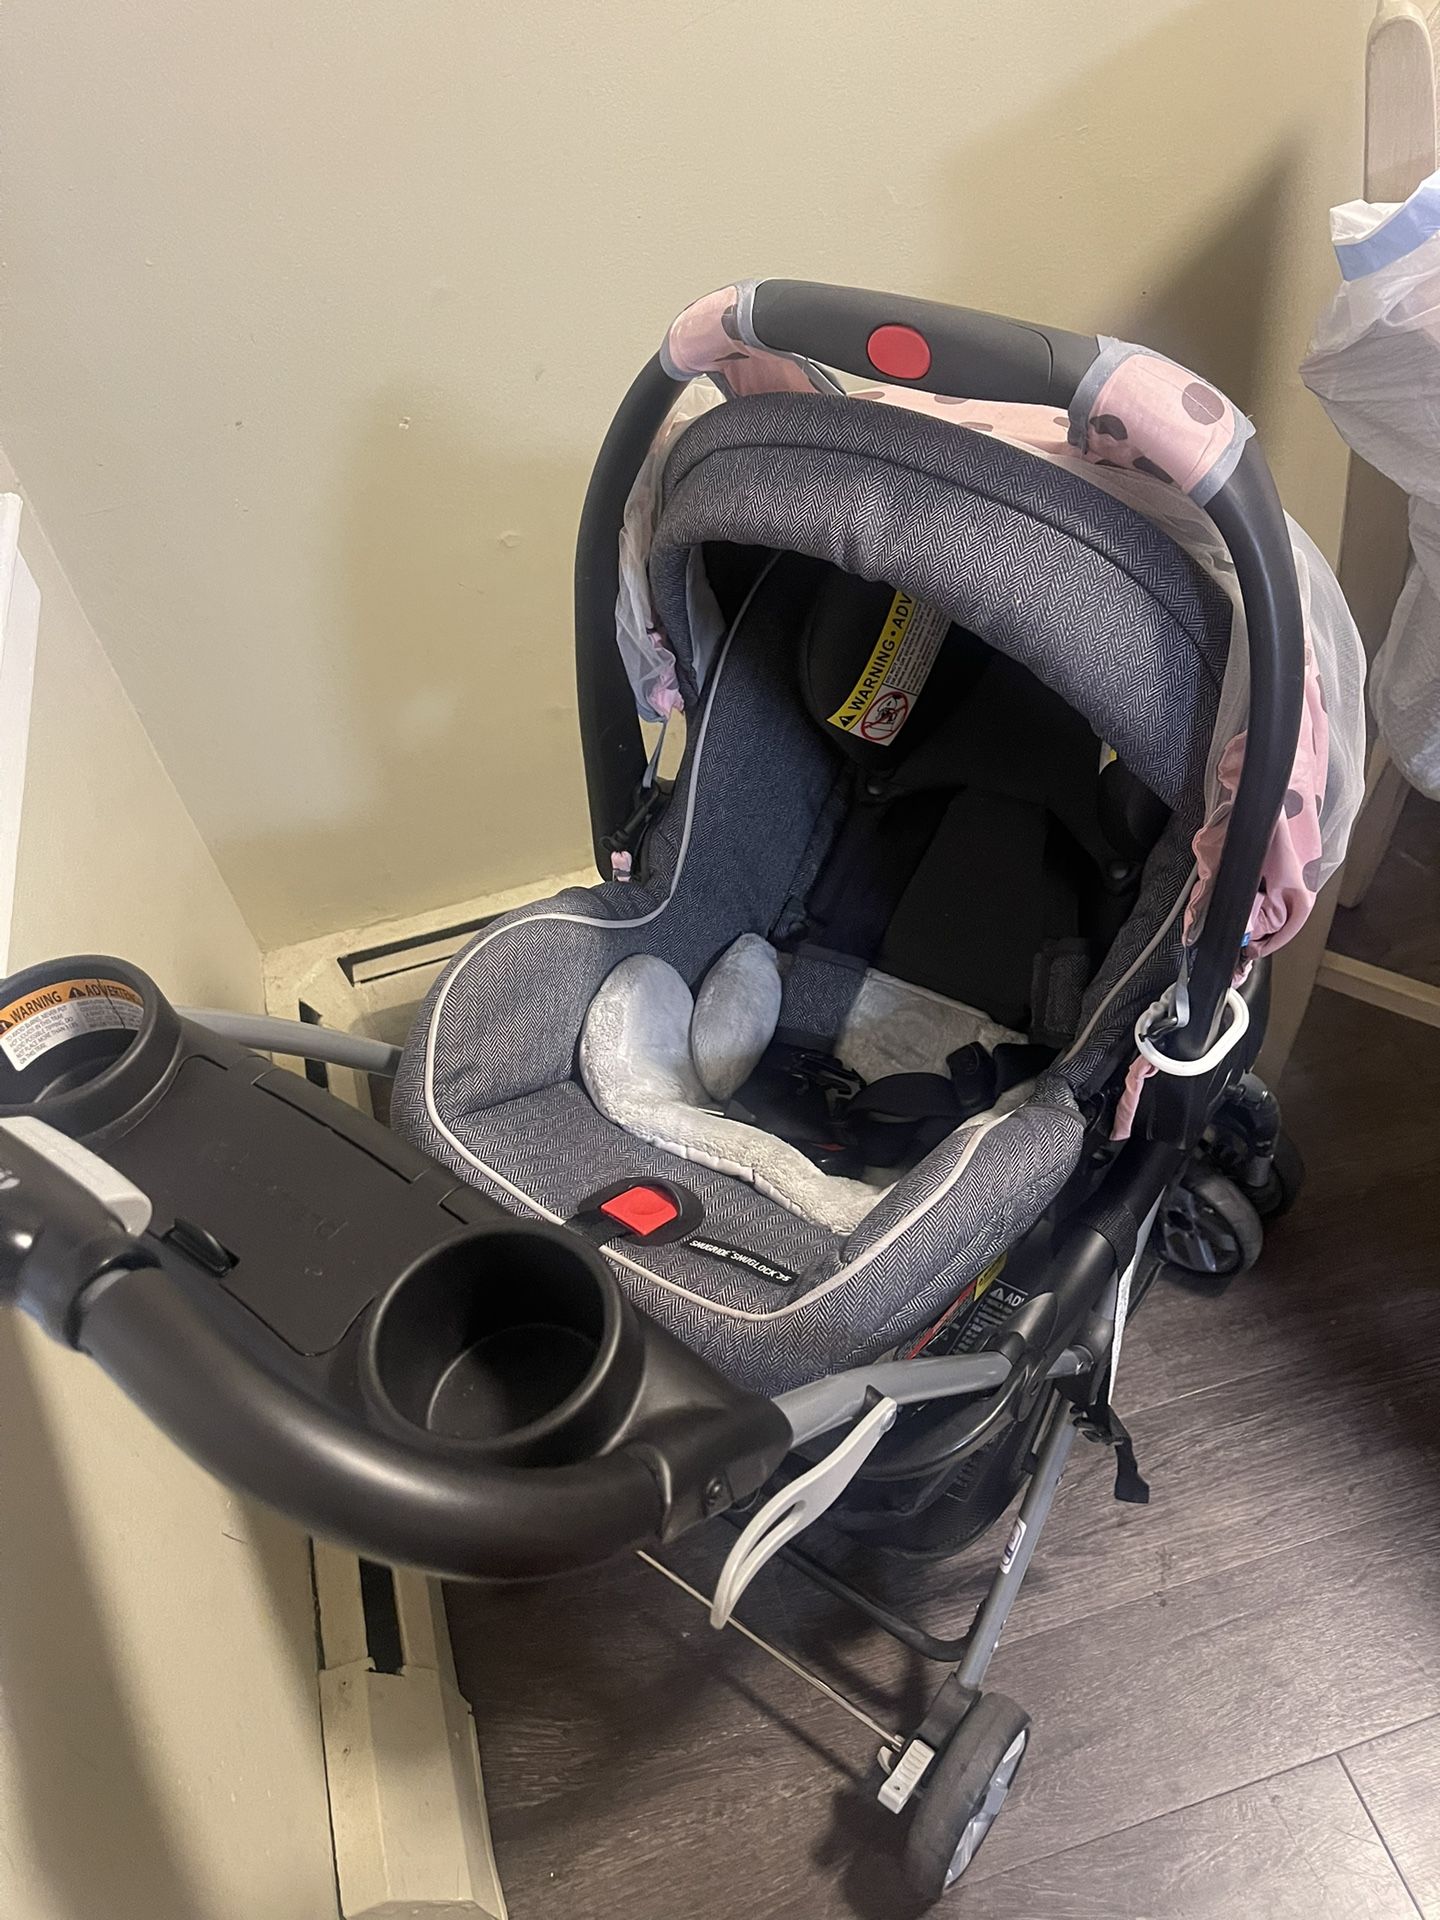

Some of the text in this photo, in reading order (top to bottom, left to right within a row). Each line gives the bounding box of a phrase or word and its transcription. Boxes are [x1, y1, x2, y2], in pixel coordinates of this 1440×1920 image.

[848, 639, 895, 711] WARNING
[10, 991, 62, 1023] WARNING
[731, 1252, 776, 1277] SNUGLOCK
[1004, 1292, 1025, 1307] AD
